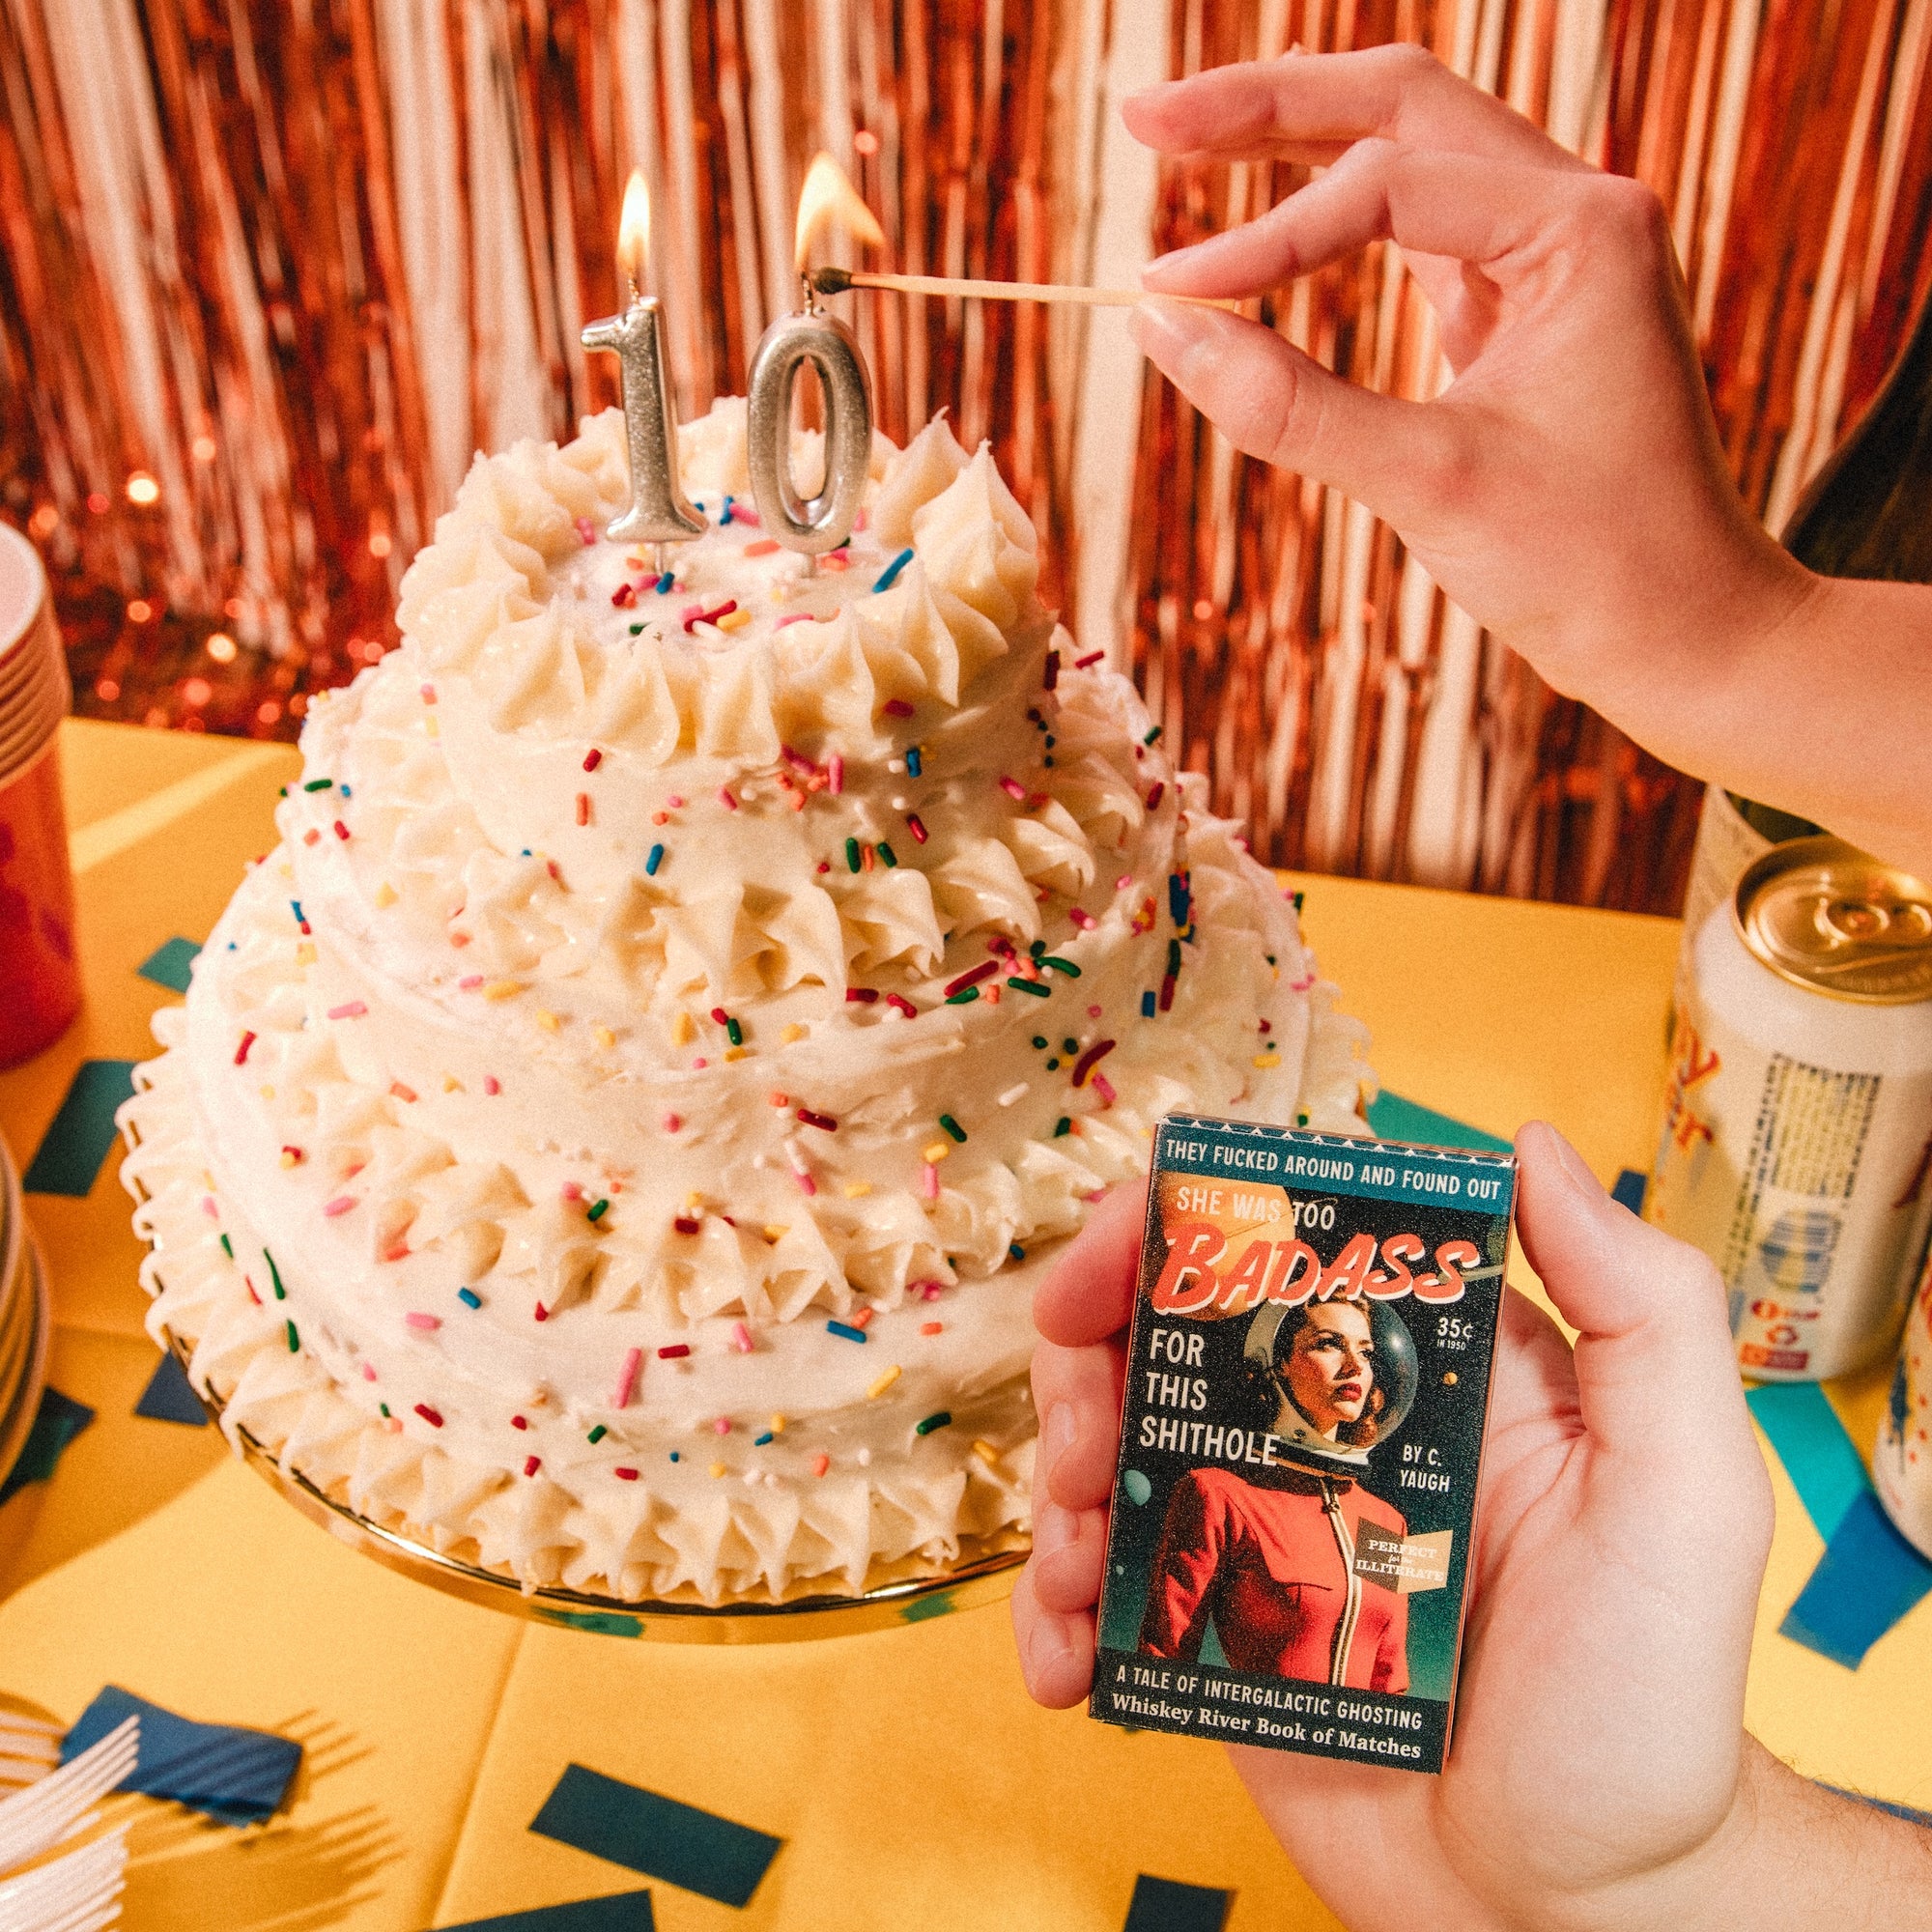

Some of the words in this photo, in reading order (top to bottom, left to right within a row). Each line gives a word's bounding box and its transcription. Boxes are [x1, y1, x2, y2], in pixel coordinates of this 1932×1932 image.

[582, 296, 872, 554] 10
[1166, 1139, 1208, 1162] THEY
[1213, 1146, 1278, 1171] FUCKED
[1284, 1155, 1353, 1180] AROUND
[1360, 1165, 1395, 1186] AND
[1402, 1170, 1460, 1195] FOUND
[1467, 1179, 1500, 1200] OUT
[1177, 1186, 1223, 1215] SHE
[1233, 1193, 1281, 1223] WAS
[1292, 1202, 1335, 1230] TOO
[1151, 1222, 1480, 1315] BADASS
[1150, 1328, 1205, 1367] FOR
[1436, 1317, 1473, 1340] 35¢
[1448, 1340, 1466, 1350] 1950
[1147, 1372, 1208, 1410] THIS
[1140, 1415, 1280, 1466] SHITHOLE
[1403, 1444, 1423, 1463] BY
[1428, 1448, 1442, 1467] C.
[1401, 1469, 1450, 1492] YAUGH
[1368, 1540, 1437, 1558] PERFECT
[1355, 1560, 1444, 1582] ILLITERATE
[1116, 1664, 1125, 1683] A
[1134, 1667, 1171, 1690] TALE
[1177, 1675, 1199, 1693] OF
[1205, 1679, 1330, 1716] INTERGALACTIC
[1337, 1701, 1423, 1730] GHOSTING
[1112, 1692, 1193, 1725] Whiskey
[1198, 1708, 1250, 1731] River
[1256, 1717, 1306, 1741] Book
[1313, 1727, 1335, 1746] of
[1338, 1730, 1421, 1758] Matches
